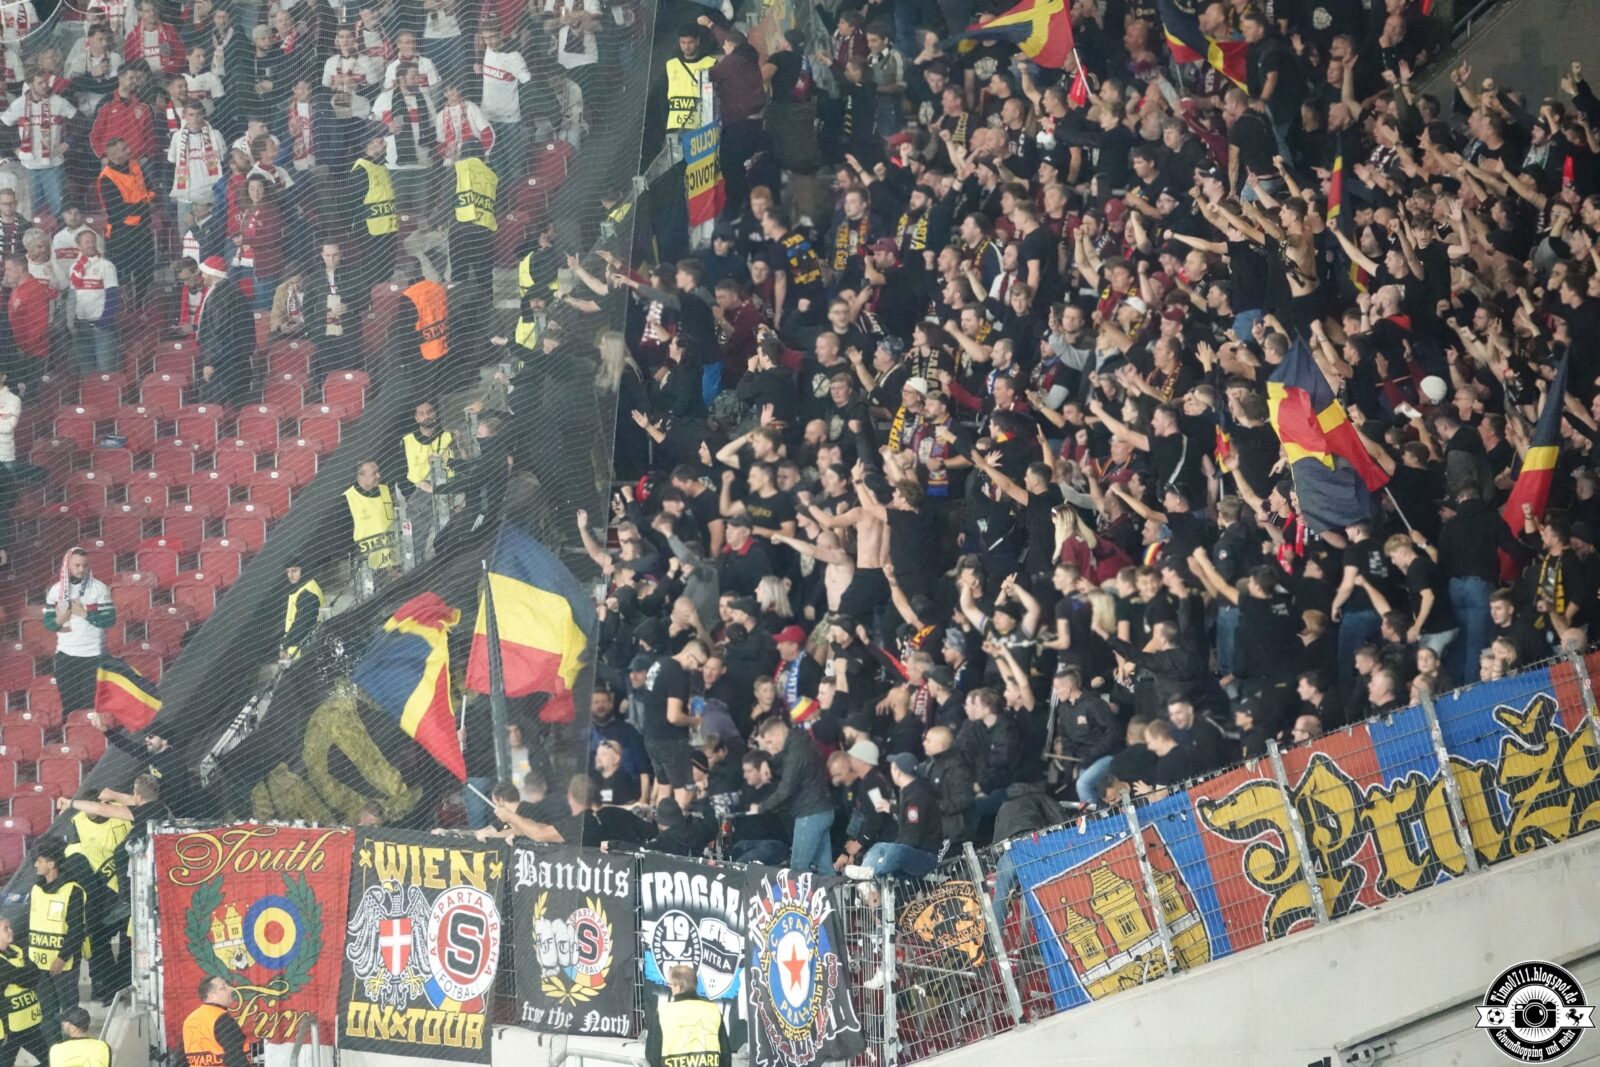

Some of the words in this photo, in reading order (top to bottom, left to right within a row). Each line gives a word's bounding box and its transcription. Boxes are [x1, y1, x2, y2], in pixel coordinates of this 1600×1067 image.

[169, 826, 348, 887] Youth
[374, 841, 487, 891] WIEN
[513, 848, 631, 898] Bandits
[433, 891, 483, 924] SPARTA
[484, 910, 499, 976] PRAHA
[663, 915, 690, 941] 19
[576, 963, 602, 974] OTBAL
[702, 947, 732, 971] NITRA
[547, 1006, 574, 1030] the
[578, 1009, 630, 1037] North
